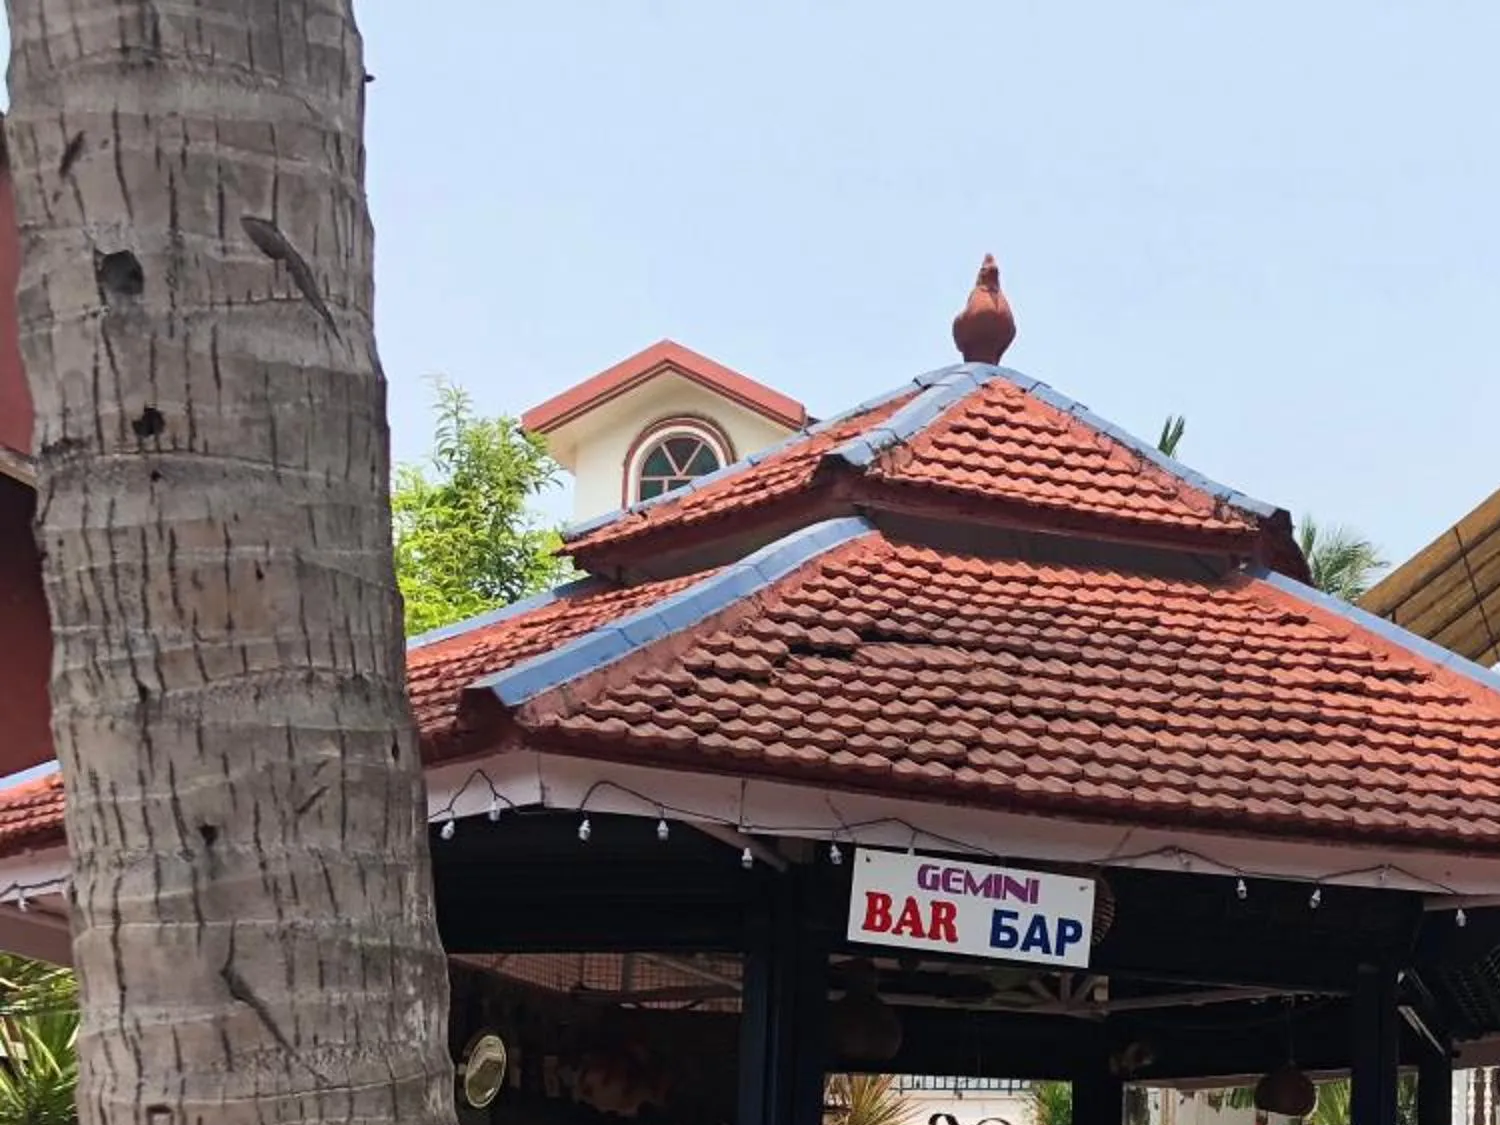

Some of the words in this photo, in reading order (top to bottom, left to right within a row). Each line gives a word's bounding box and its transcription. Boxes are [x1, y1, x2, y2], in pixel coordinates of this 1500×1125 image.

[917, 863, 1040, 904] GEMINI
[861, 891, 959, 943] BAR
[989, 909, 1083, 957] БАР
